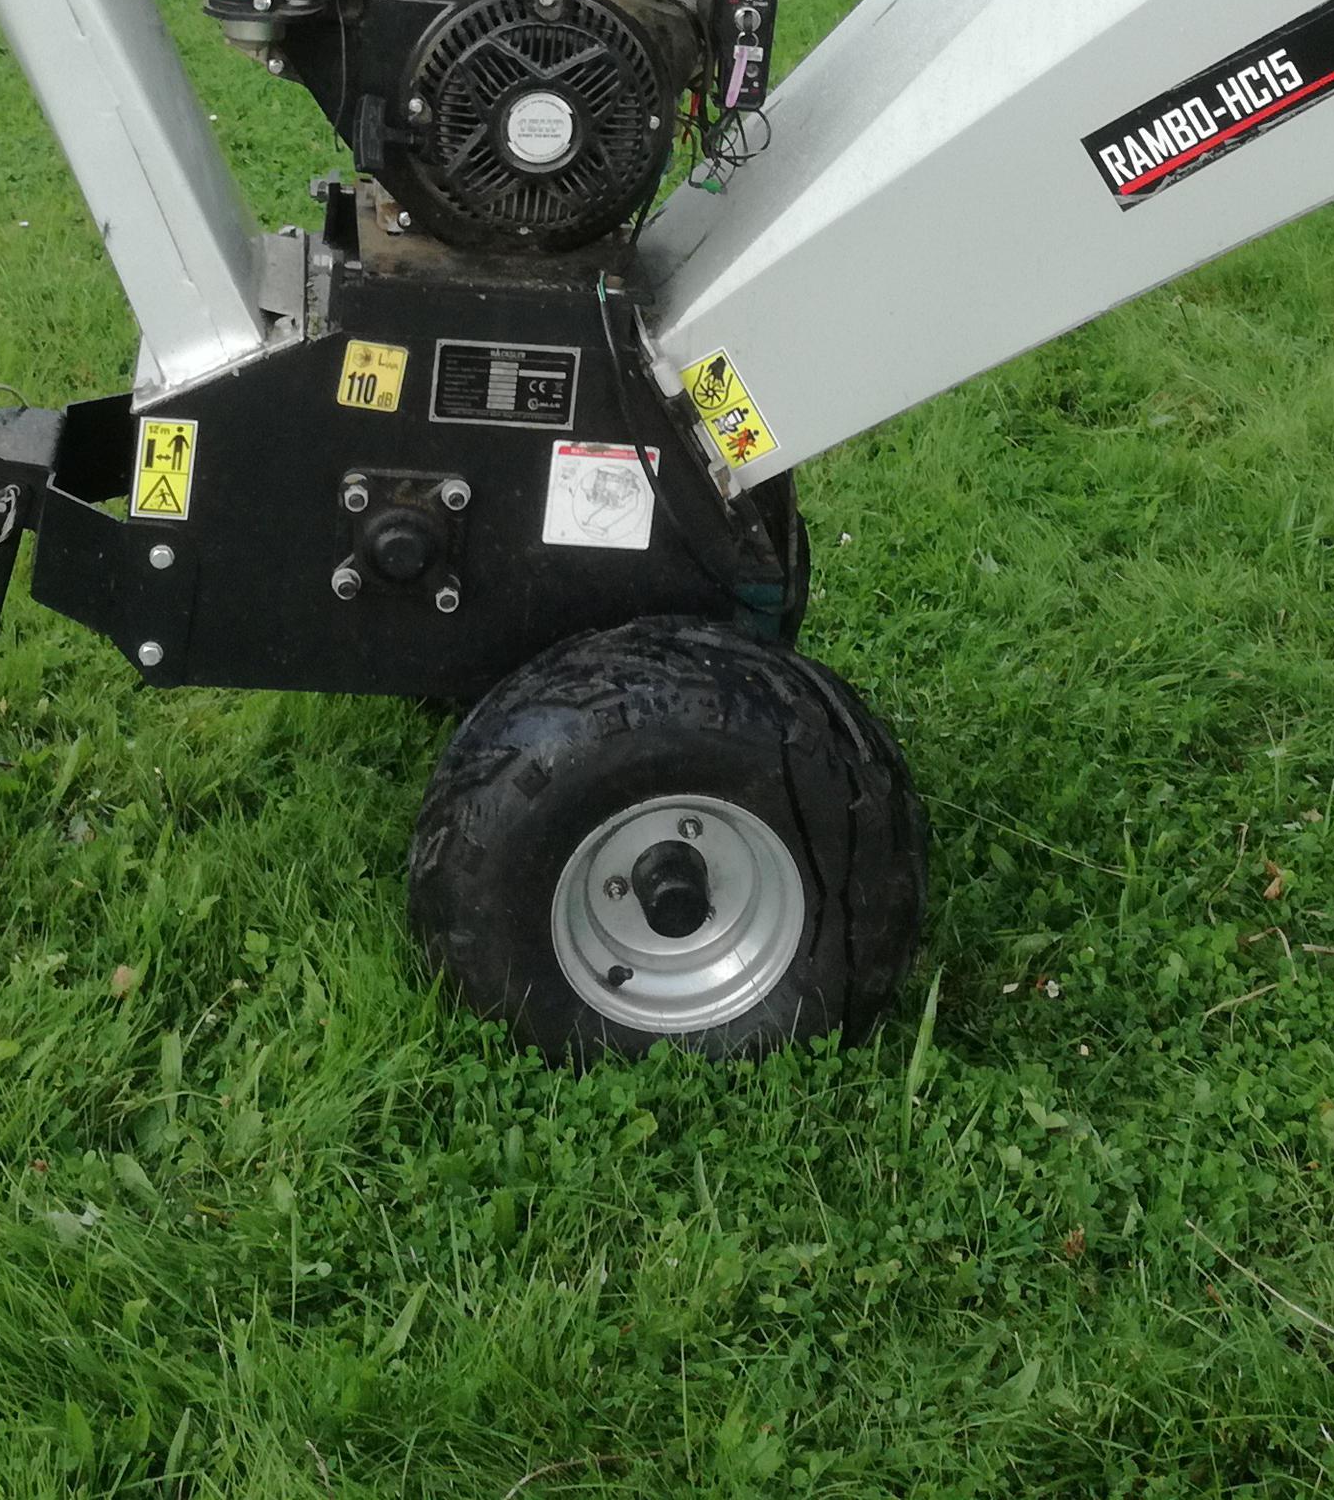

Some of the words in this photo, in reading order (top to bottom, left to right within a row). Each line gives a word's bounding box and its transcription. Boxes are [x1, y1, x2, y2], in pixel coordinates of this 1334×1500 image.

[1098, 47, 1304, 187] RAMBO-HC15
[347, 371, 378, 405] 110
[376, 391, 394, 407] dB
